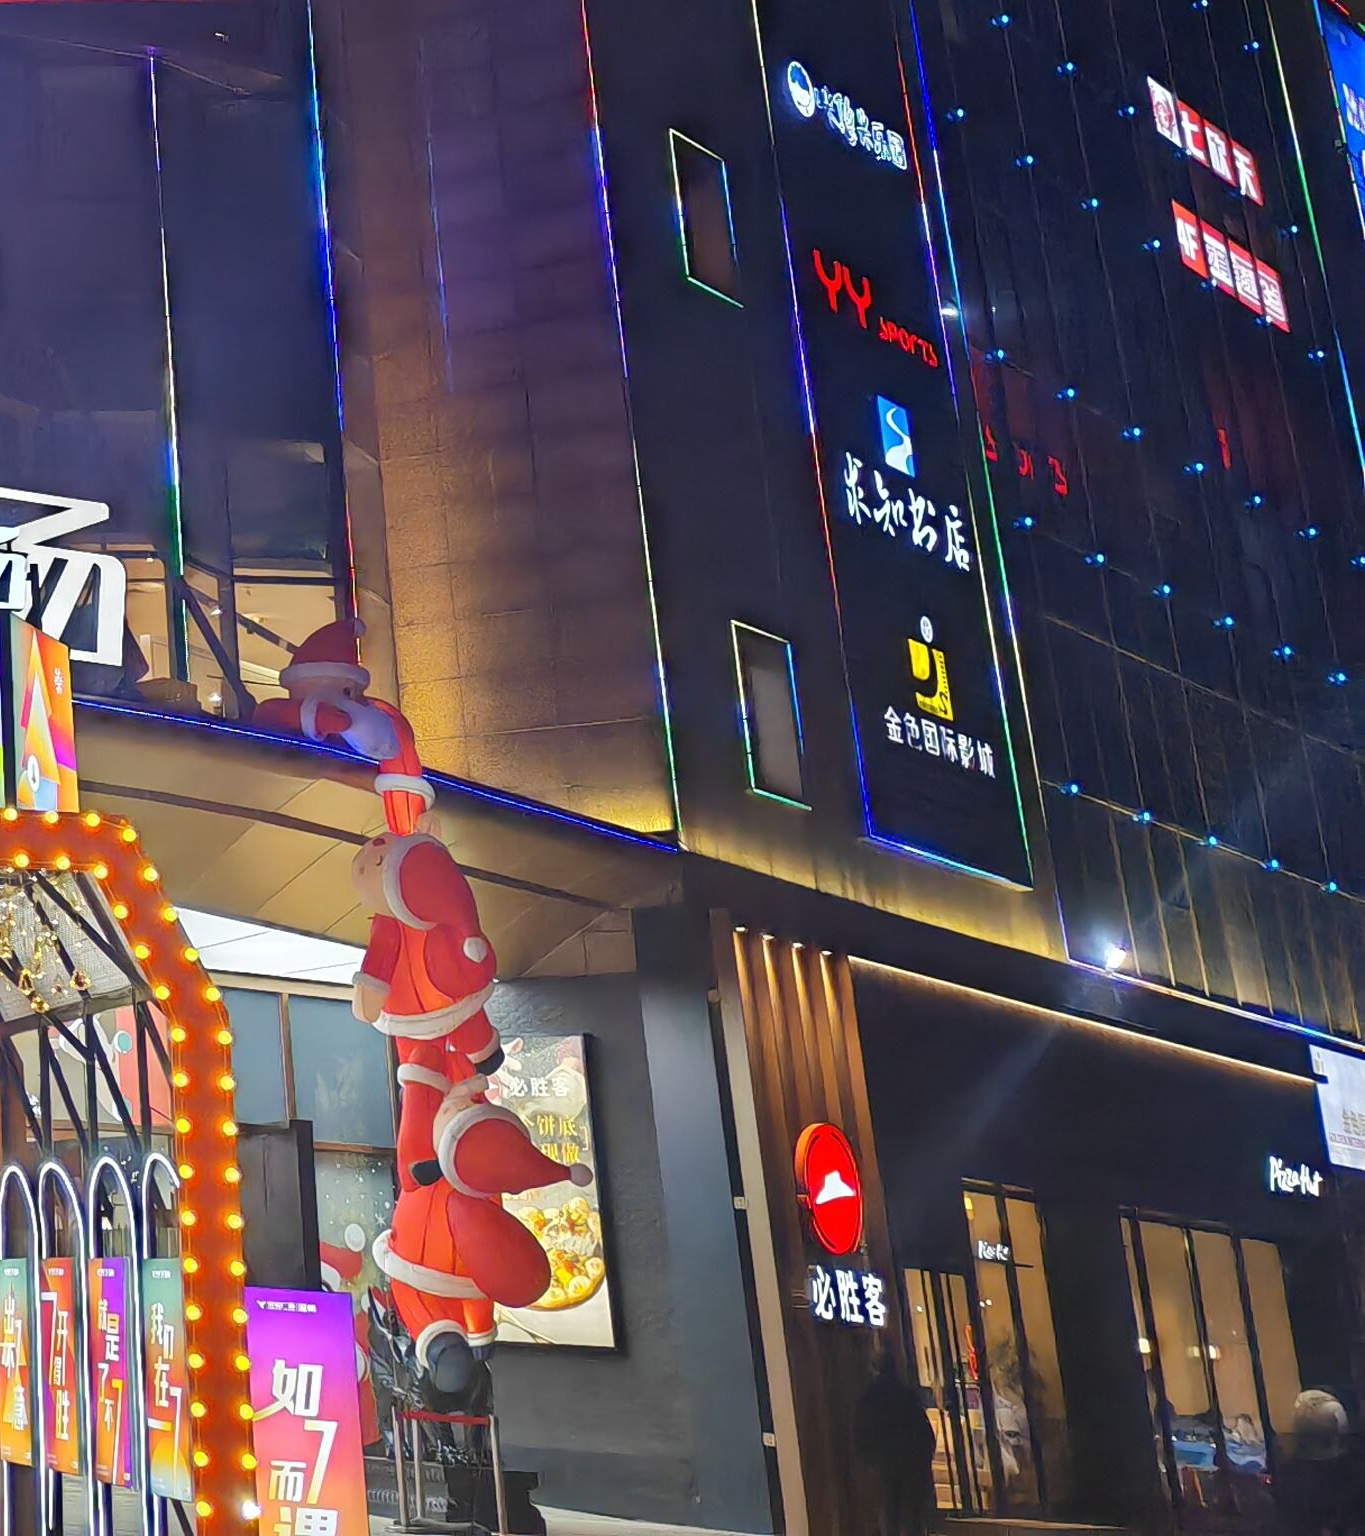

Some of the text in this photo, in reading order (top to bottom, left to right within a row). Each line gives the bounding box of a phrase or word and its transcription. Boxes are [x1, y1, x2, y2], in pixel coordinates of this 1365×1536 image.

[884, 705, 995, 778] 金色国际影城
[812, 1264, 886, 1326] 必胜客
